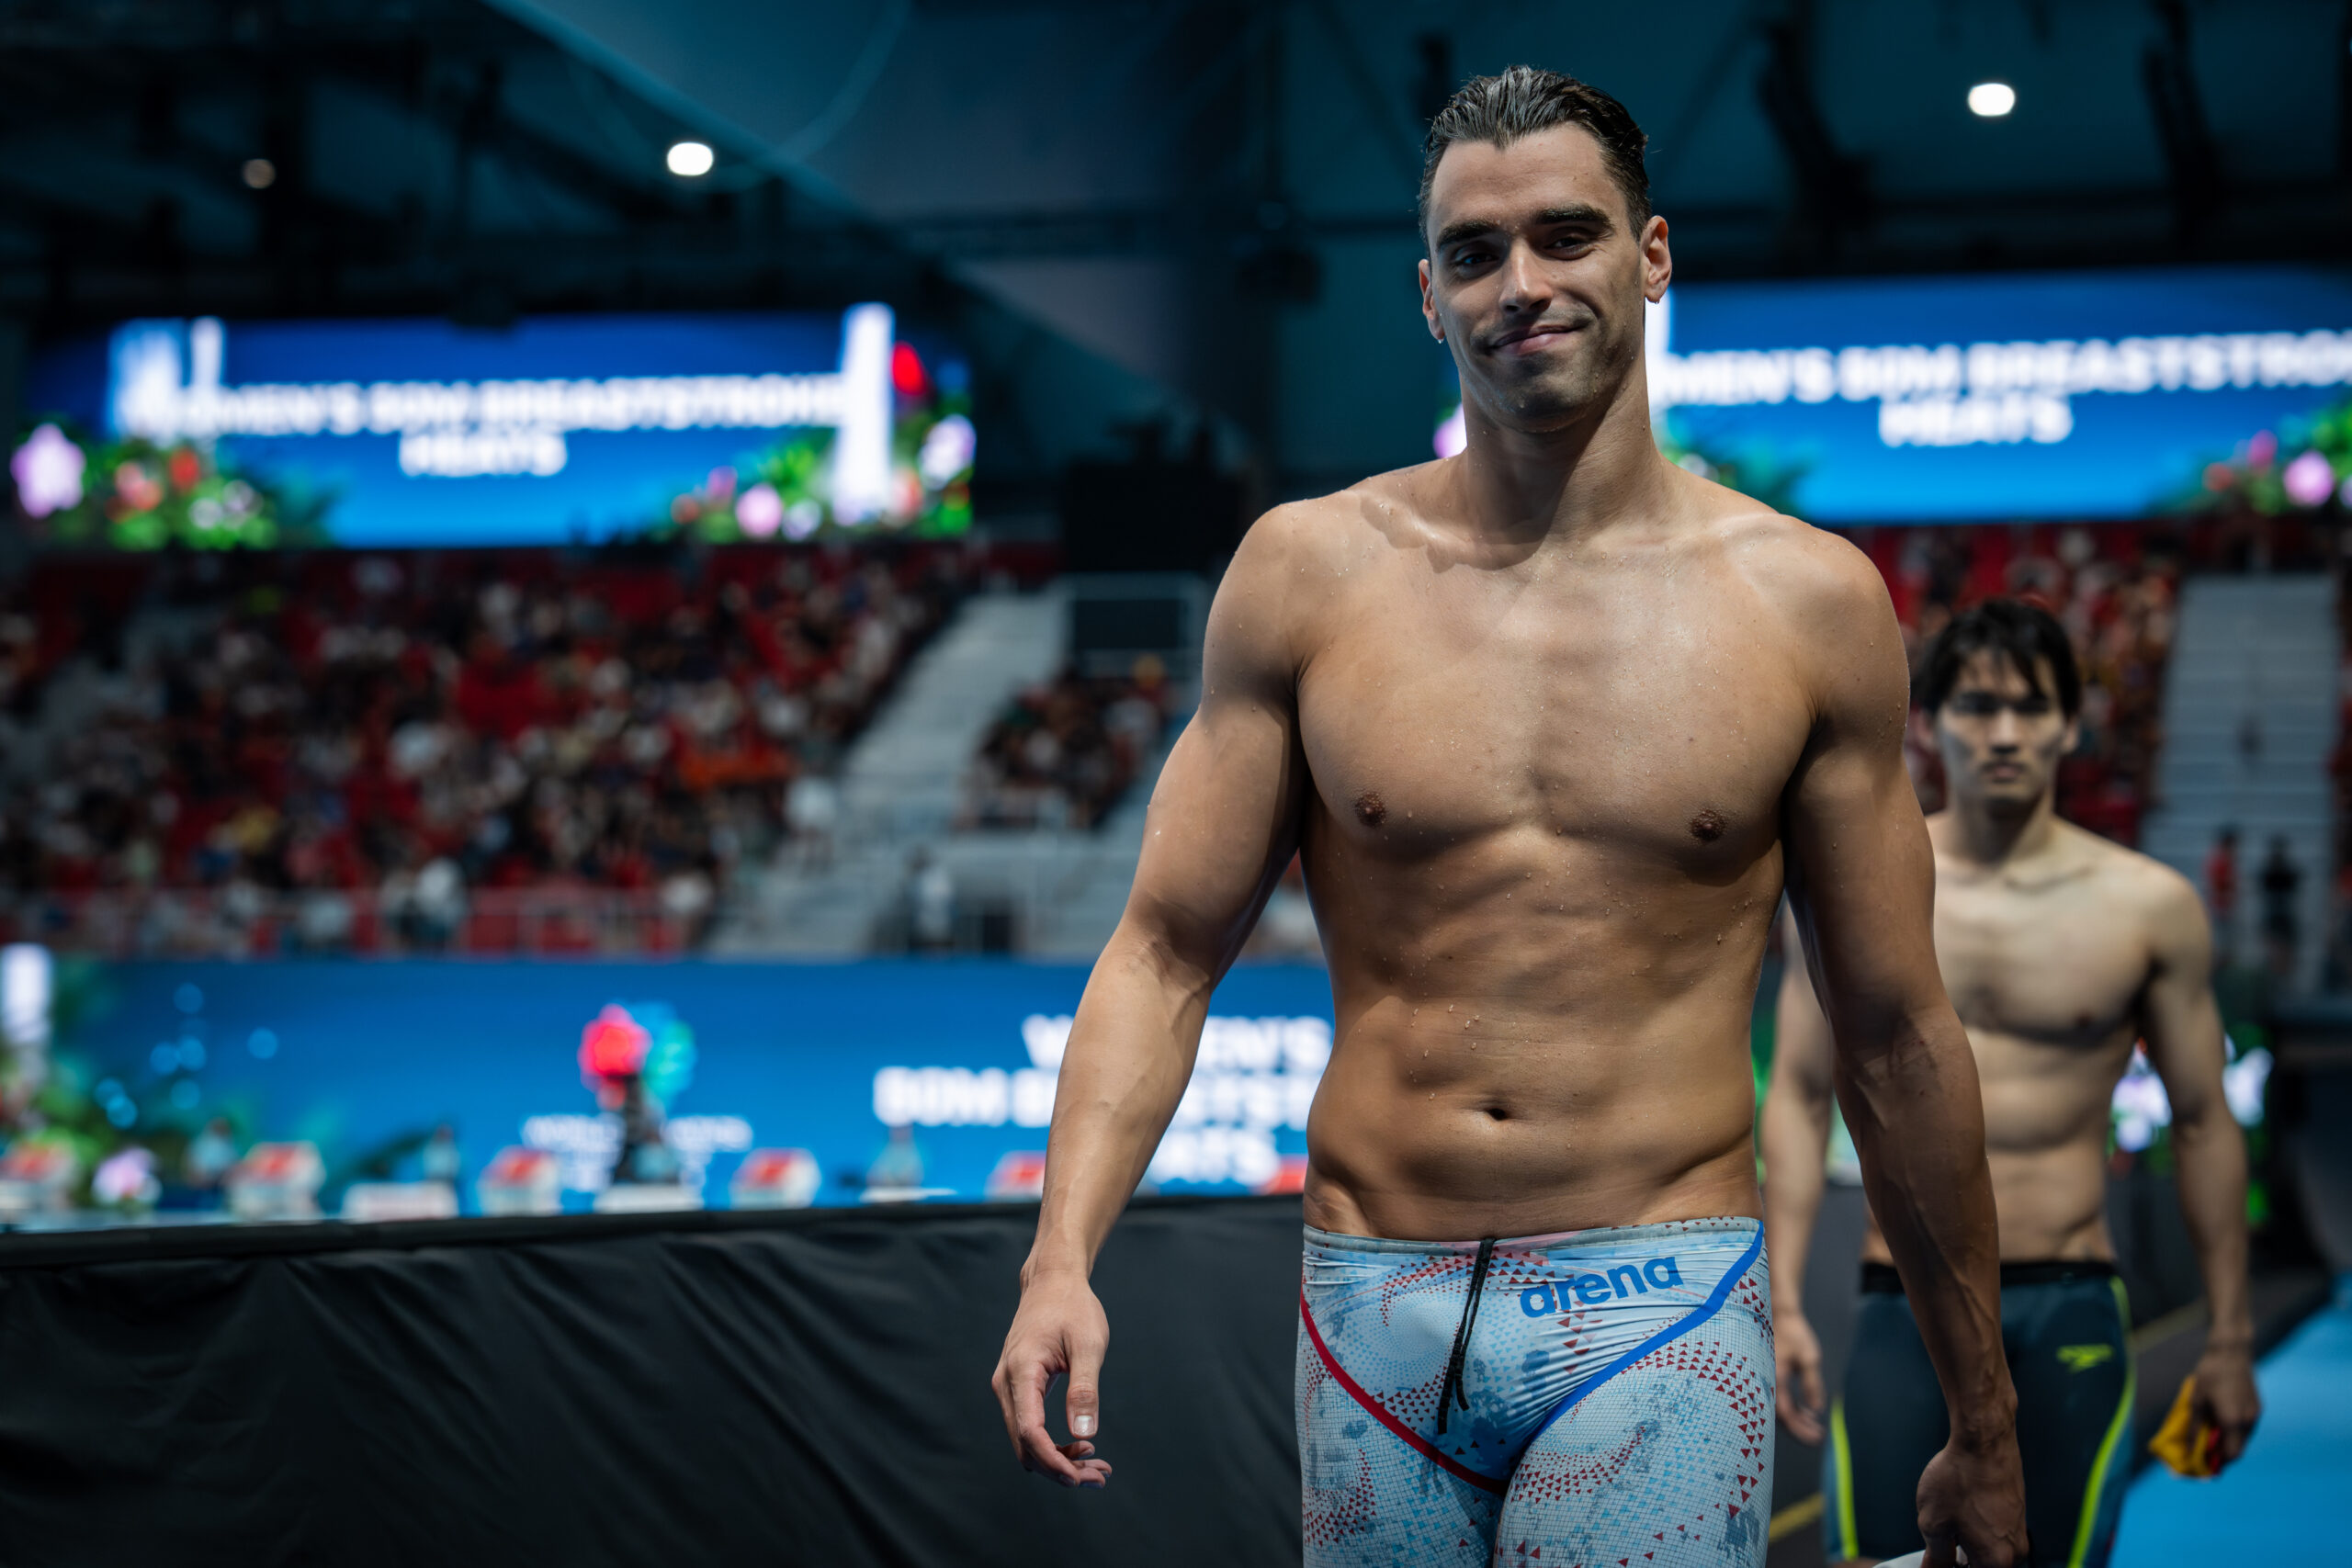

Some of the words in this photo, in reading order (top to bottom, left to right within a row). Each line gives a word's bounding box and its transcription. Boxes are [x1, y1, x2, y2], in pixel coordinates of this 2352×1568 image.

[1663, 347, 1836, 406] MEN'S
[1967, 328, 2352, 395] BREASTSTRO
[1520, 1256, 1683, 1318] arena
